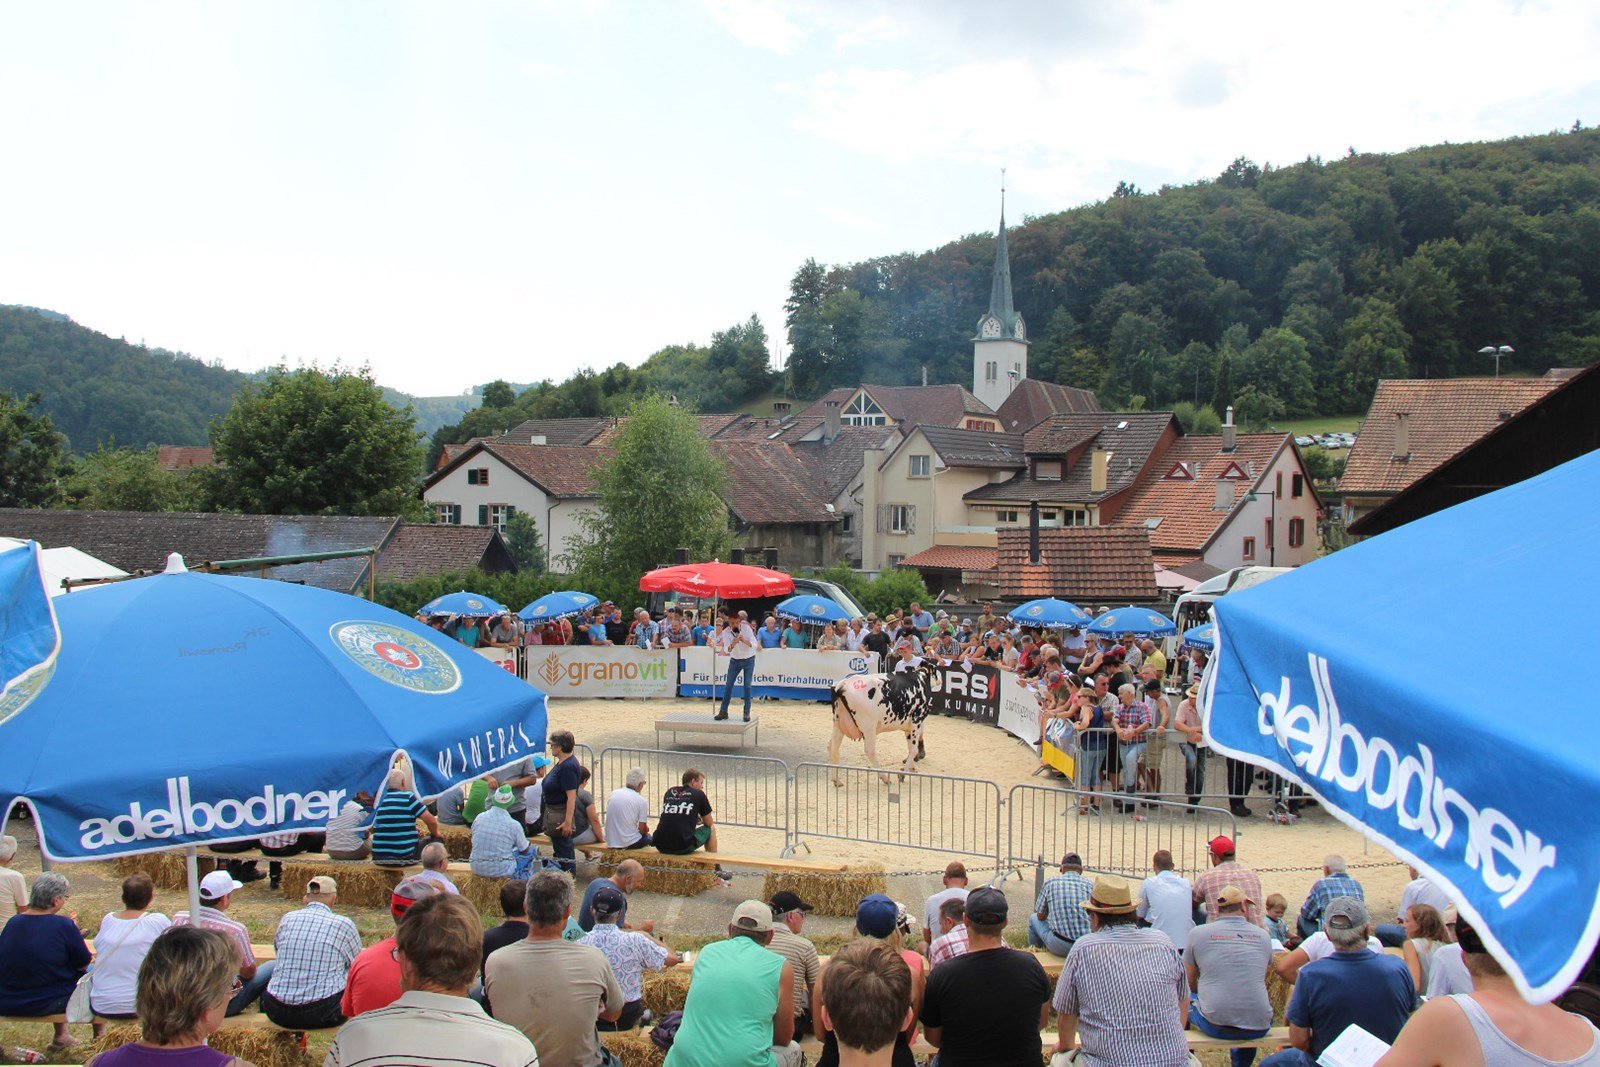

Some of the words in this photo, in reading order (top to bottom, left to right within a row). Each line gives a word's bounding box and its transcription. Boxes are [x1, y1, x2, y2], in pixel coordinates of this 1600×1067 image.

[568, 658, 667, 687] granovit
[851, 658, 865, 670] UFA
[693, 673, 710, 682] Für
[778, 675, 834, 687] Tierhaltung
[853, 680, 868, 690] 62
[944, 699, 994, 718] KUNATH
[438, 722, 536, 781] MINERAL
[1250, 652, 1556, 909] delbodner
[79, 776, 347, 850] adelbodner
[663, 801, 694, 816] taff
